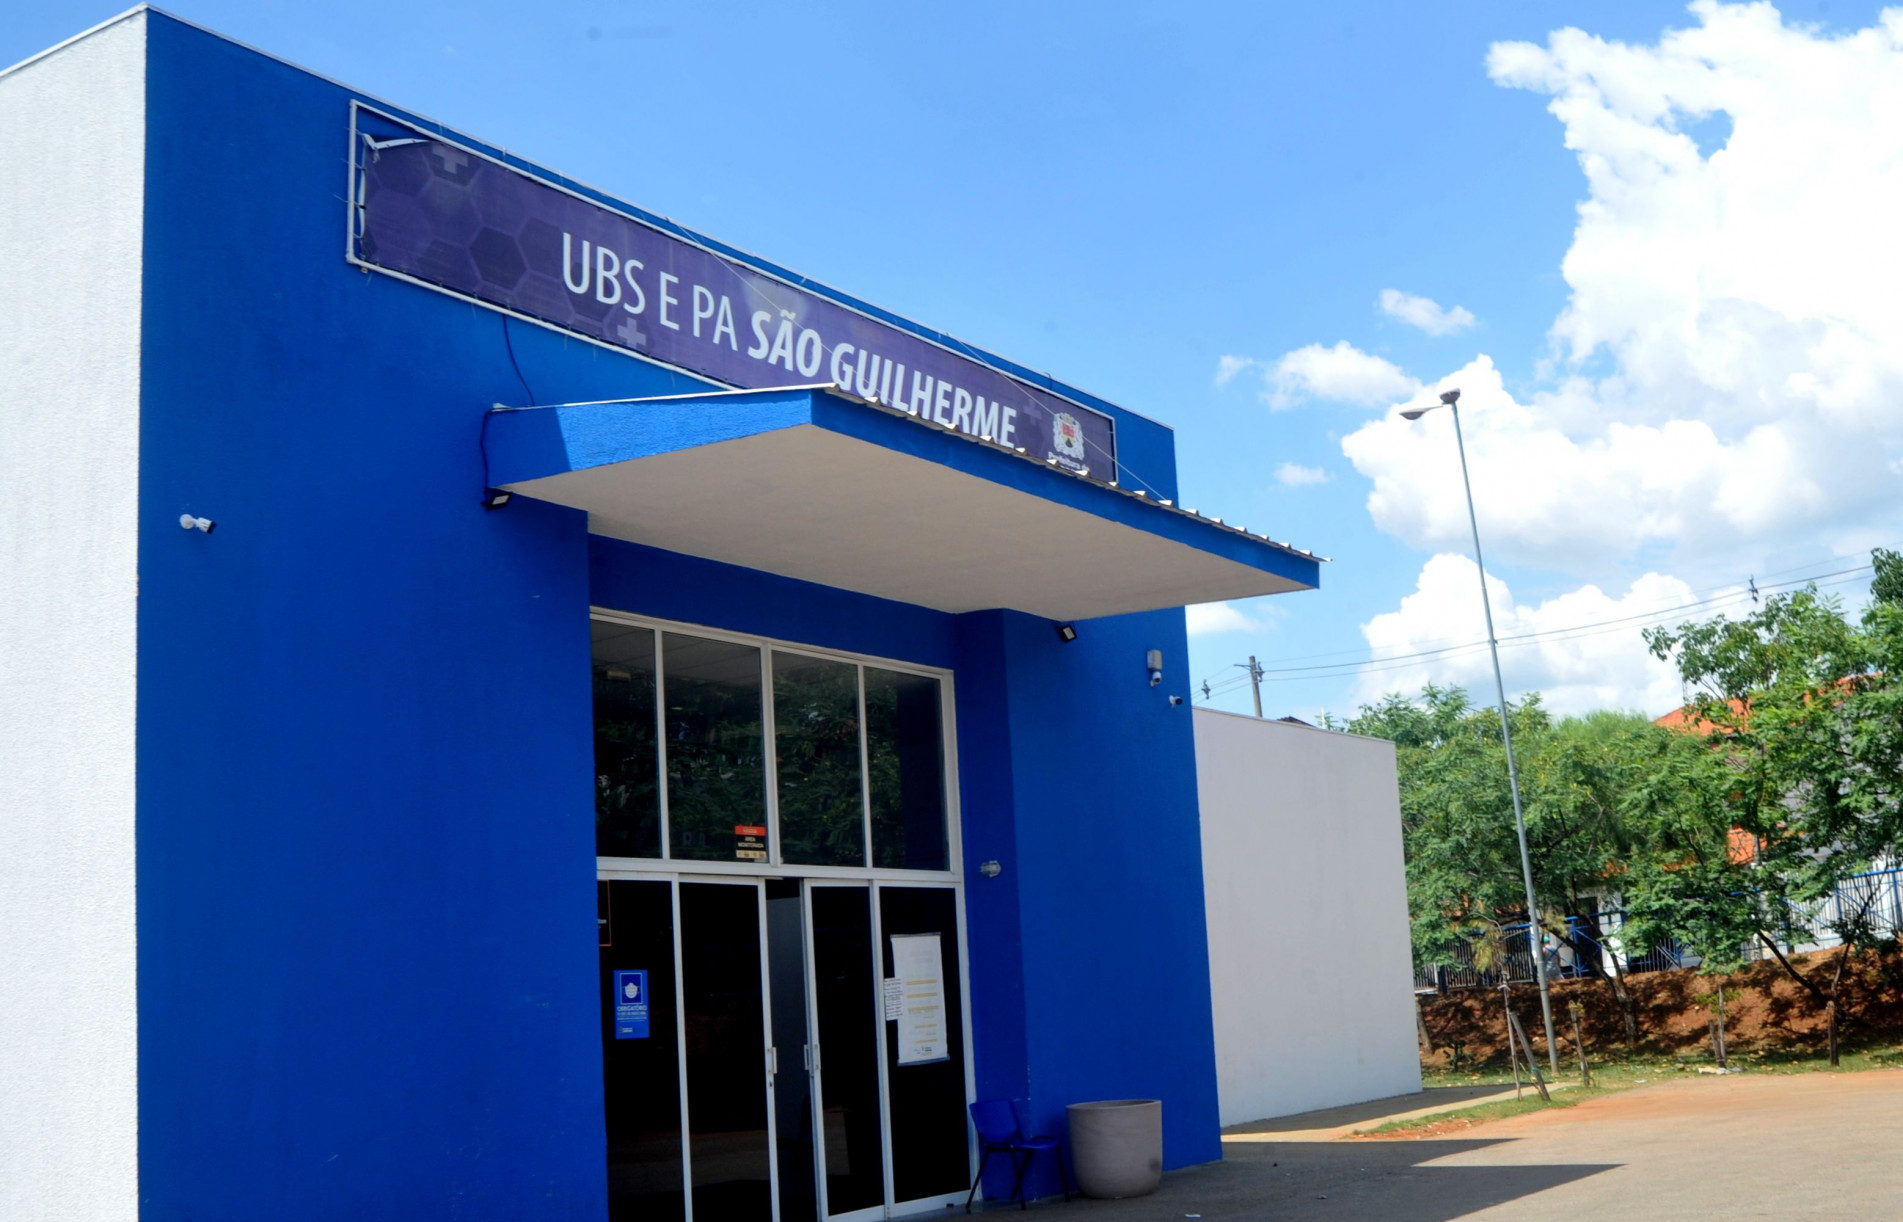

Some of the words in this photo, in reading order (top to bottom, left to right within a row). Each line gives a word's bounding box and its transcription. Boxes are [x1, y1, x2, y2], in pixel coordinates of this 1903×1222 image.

[562, 232, 646, 314] UBS
[660, 271, 680, 331] E
[693, 285, 738, 352] PA
[748, 309, 822, 378] SÃO
[830, 343, 1017, 448] GUILHERME
